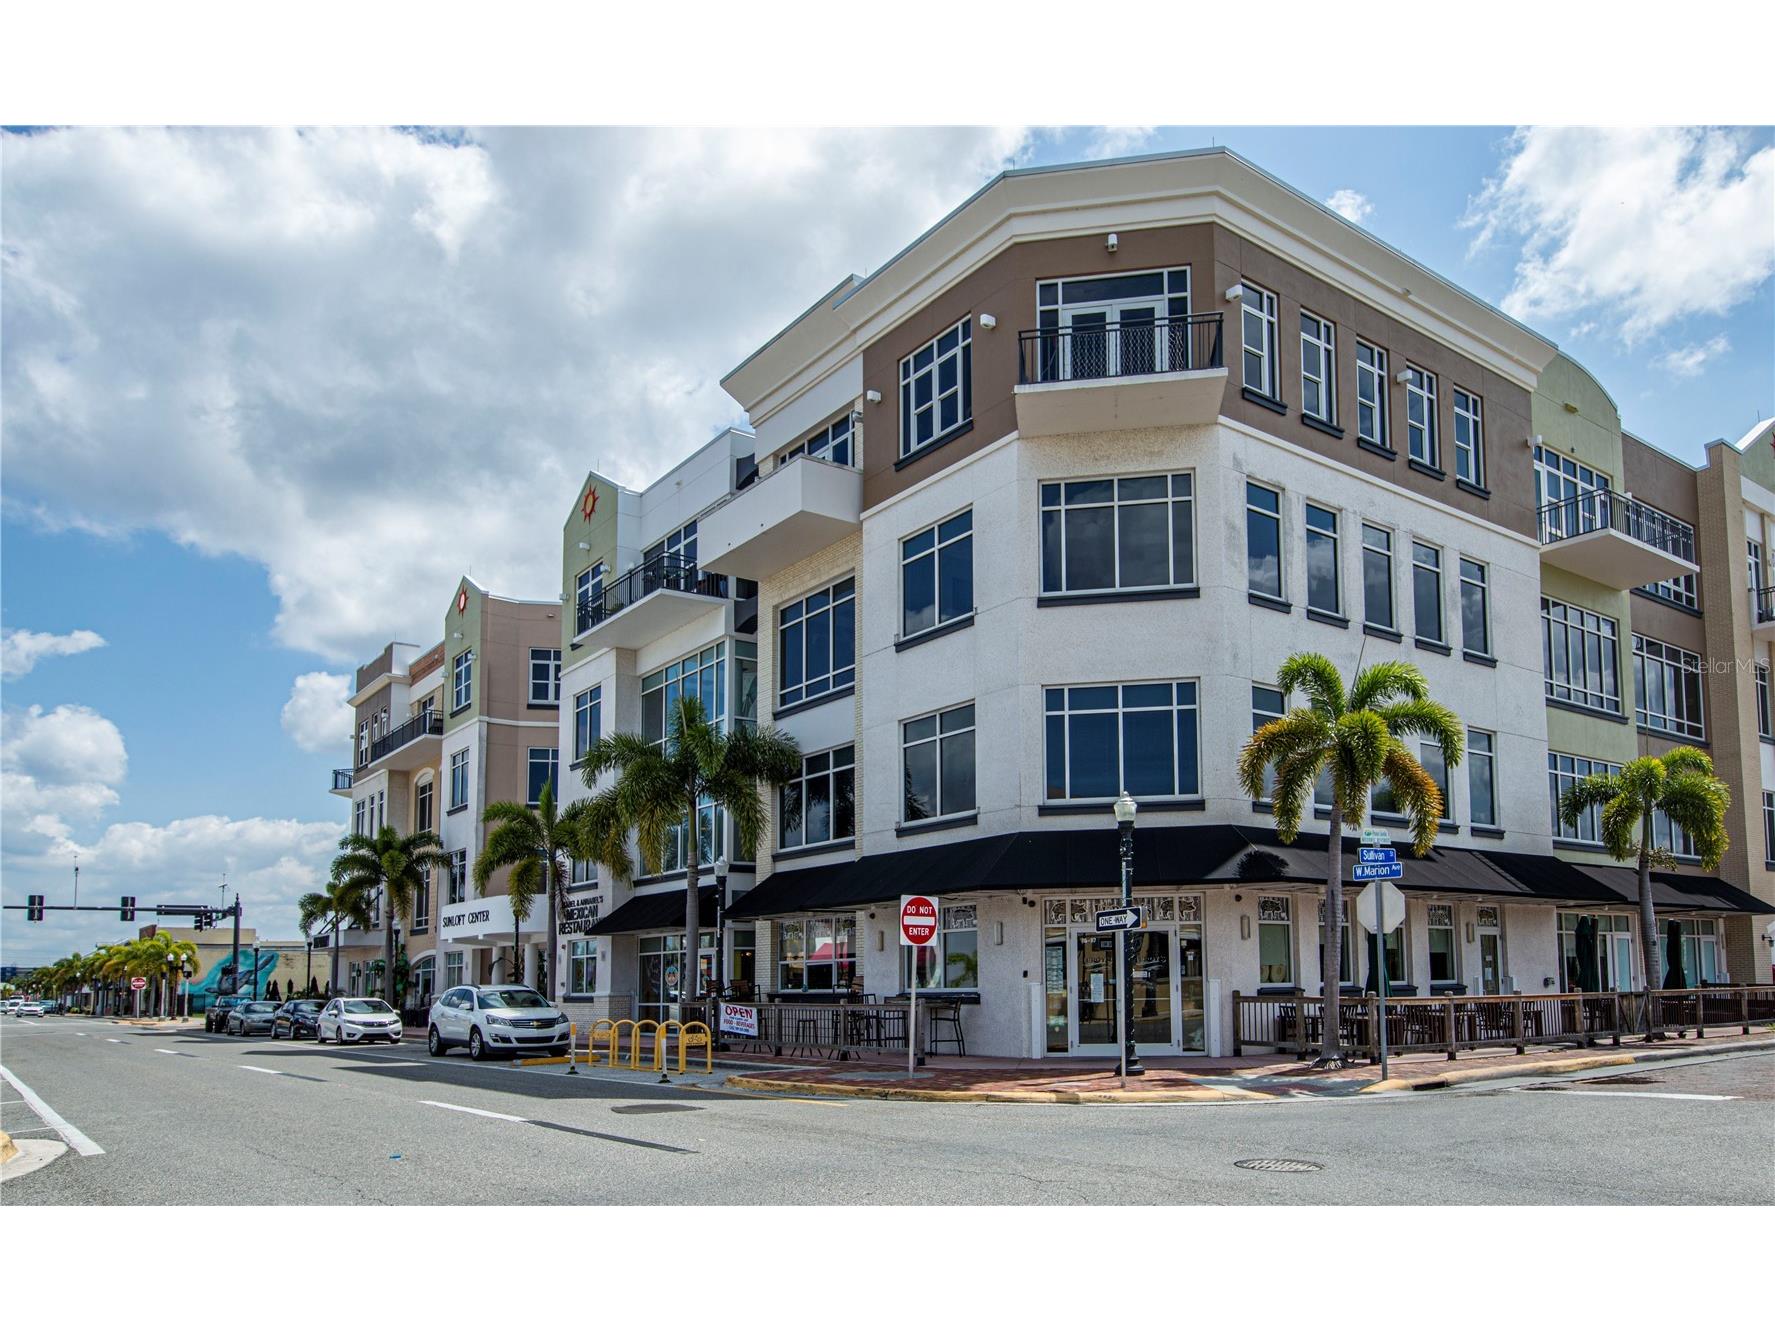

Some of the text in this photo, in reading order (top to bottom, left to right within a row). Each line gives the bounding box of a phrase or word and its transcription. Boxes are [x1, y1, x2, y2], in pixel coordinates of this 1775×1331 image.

[1362, 850, 1386, 861] Sullivan
[566, 904, 599, 921] MEXICAN
[906, 905, 933, 915] DO NOT
[442, 909, 490, 928] SUNLOFT CENTER
[1100, 915, 1128, 926] ONE WAY
[908, 927, 930, 936] ENTER
[725, 1005, 754, 1020] OPEN
